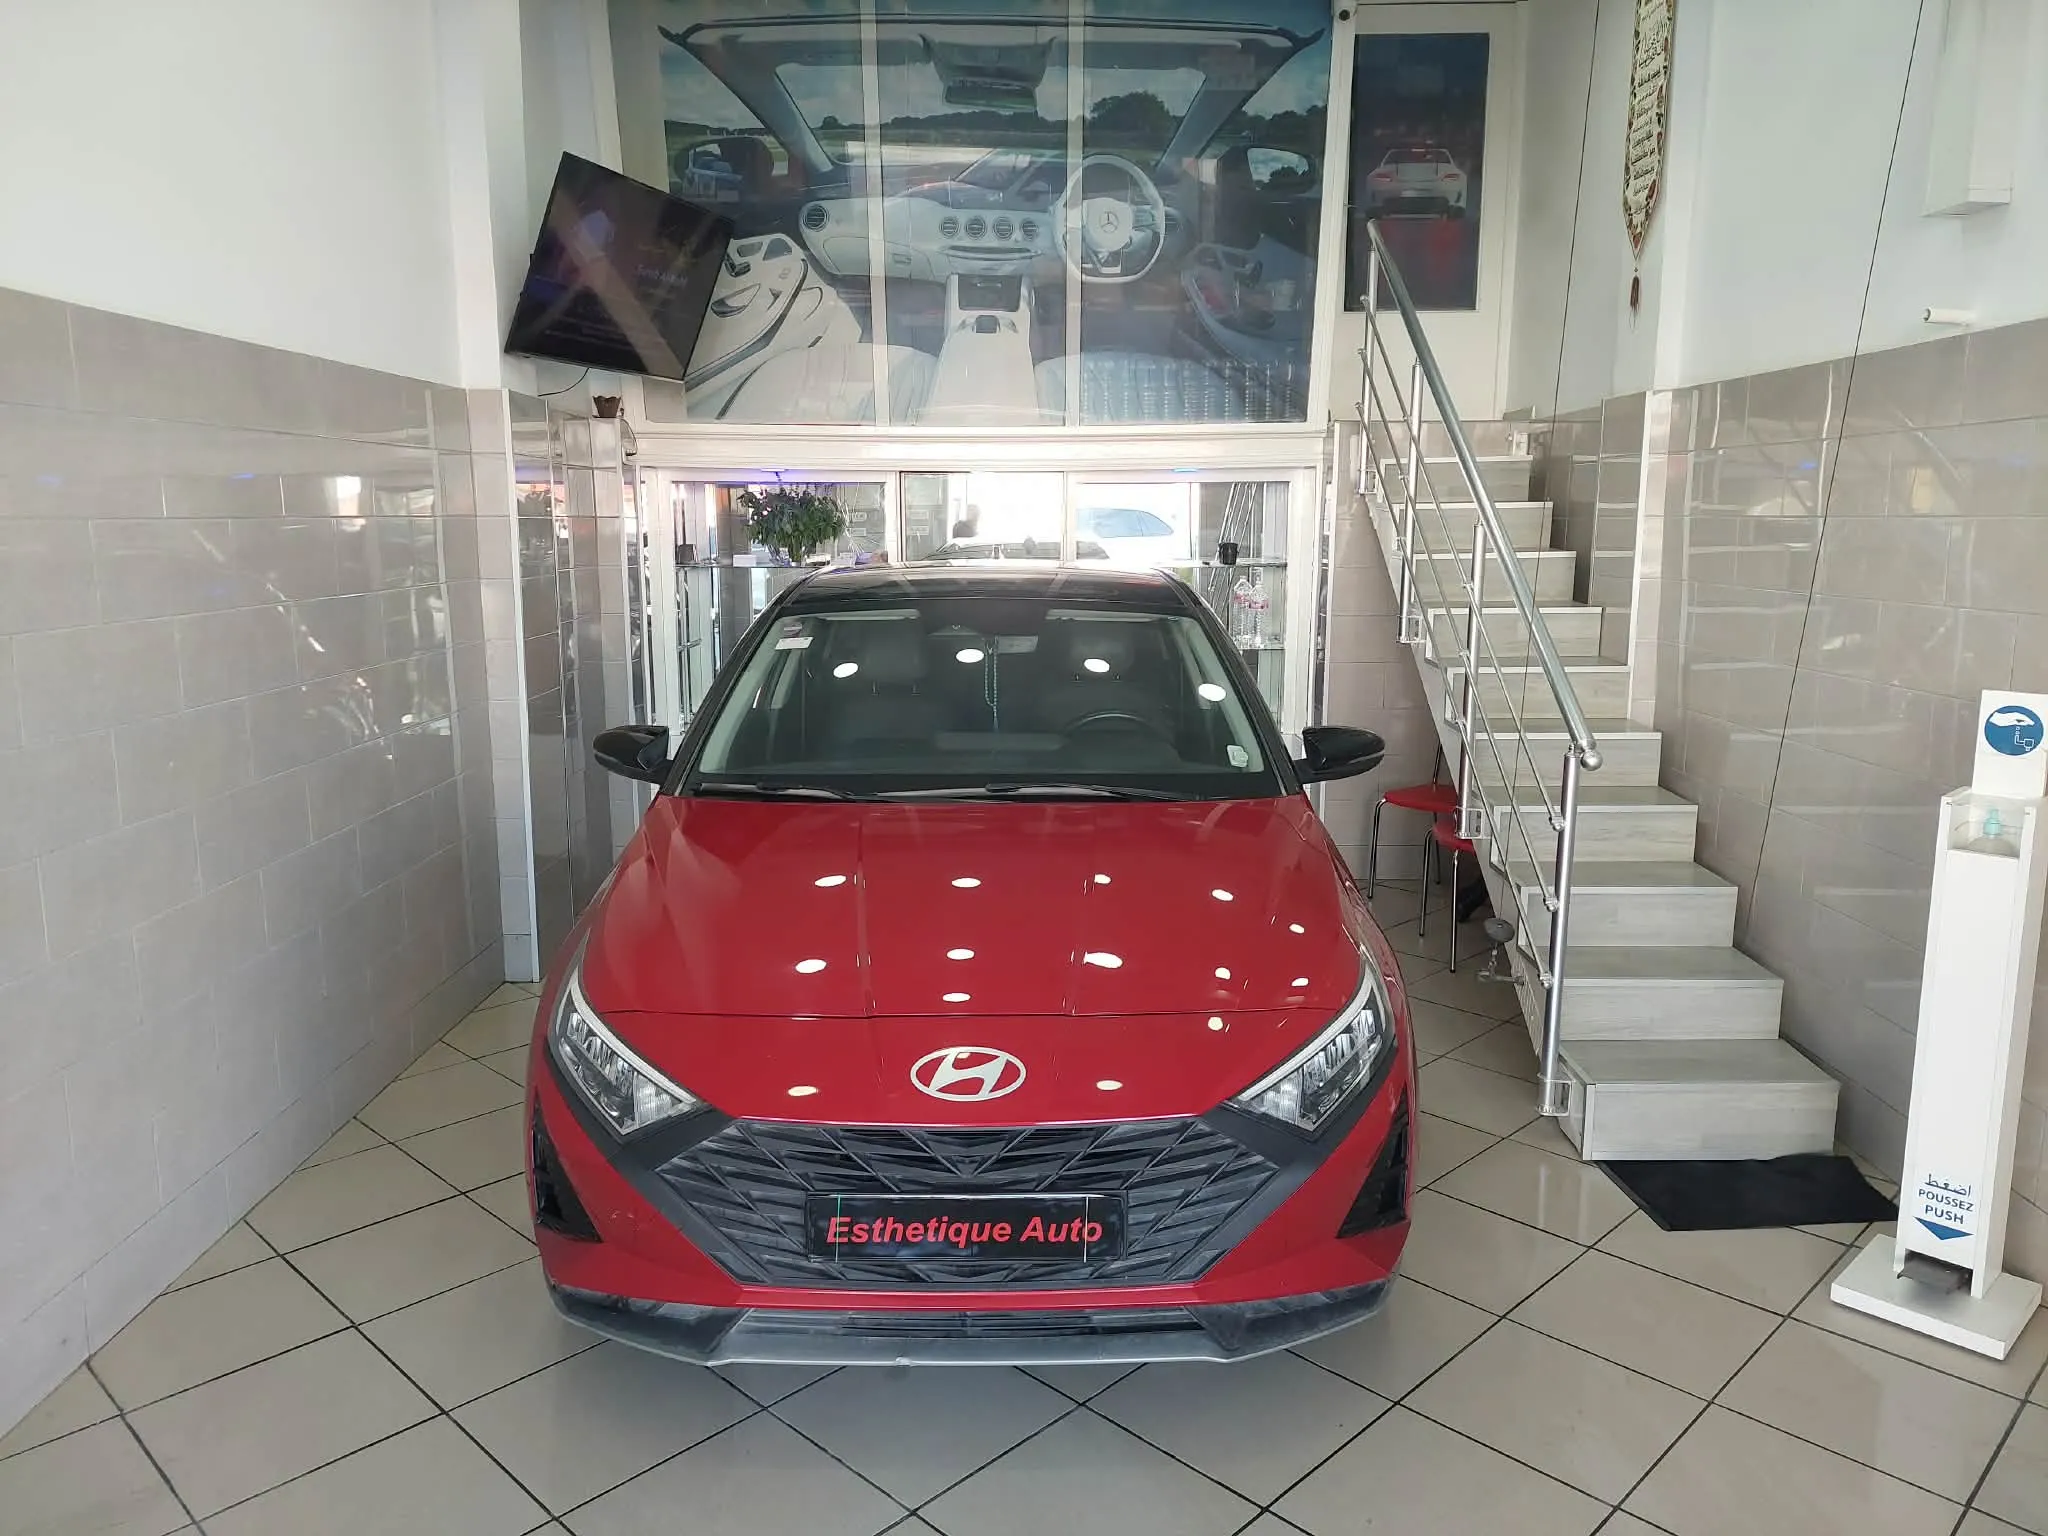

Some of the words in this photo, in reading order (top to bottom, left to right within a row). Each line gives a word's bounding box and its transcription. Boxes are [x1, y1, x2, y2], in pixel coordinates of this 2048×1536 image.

[1924, 1173, 1971, 1197] اضغط
[1918, 1188, 1974, 1212] POUSSEZ
[1925, 1204, 1964, 1224] PUSH
[827, 1216, 1011, 1248] Esthetique
[1020, 1216, 1103, 1243] Auto
